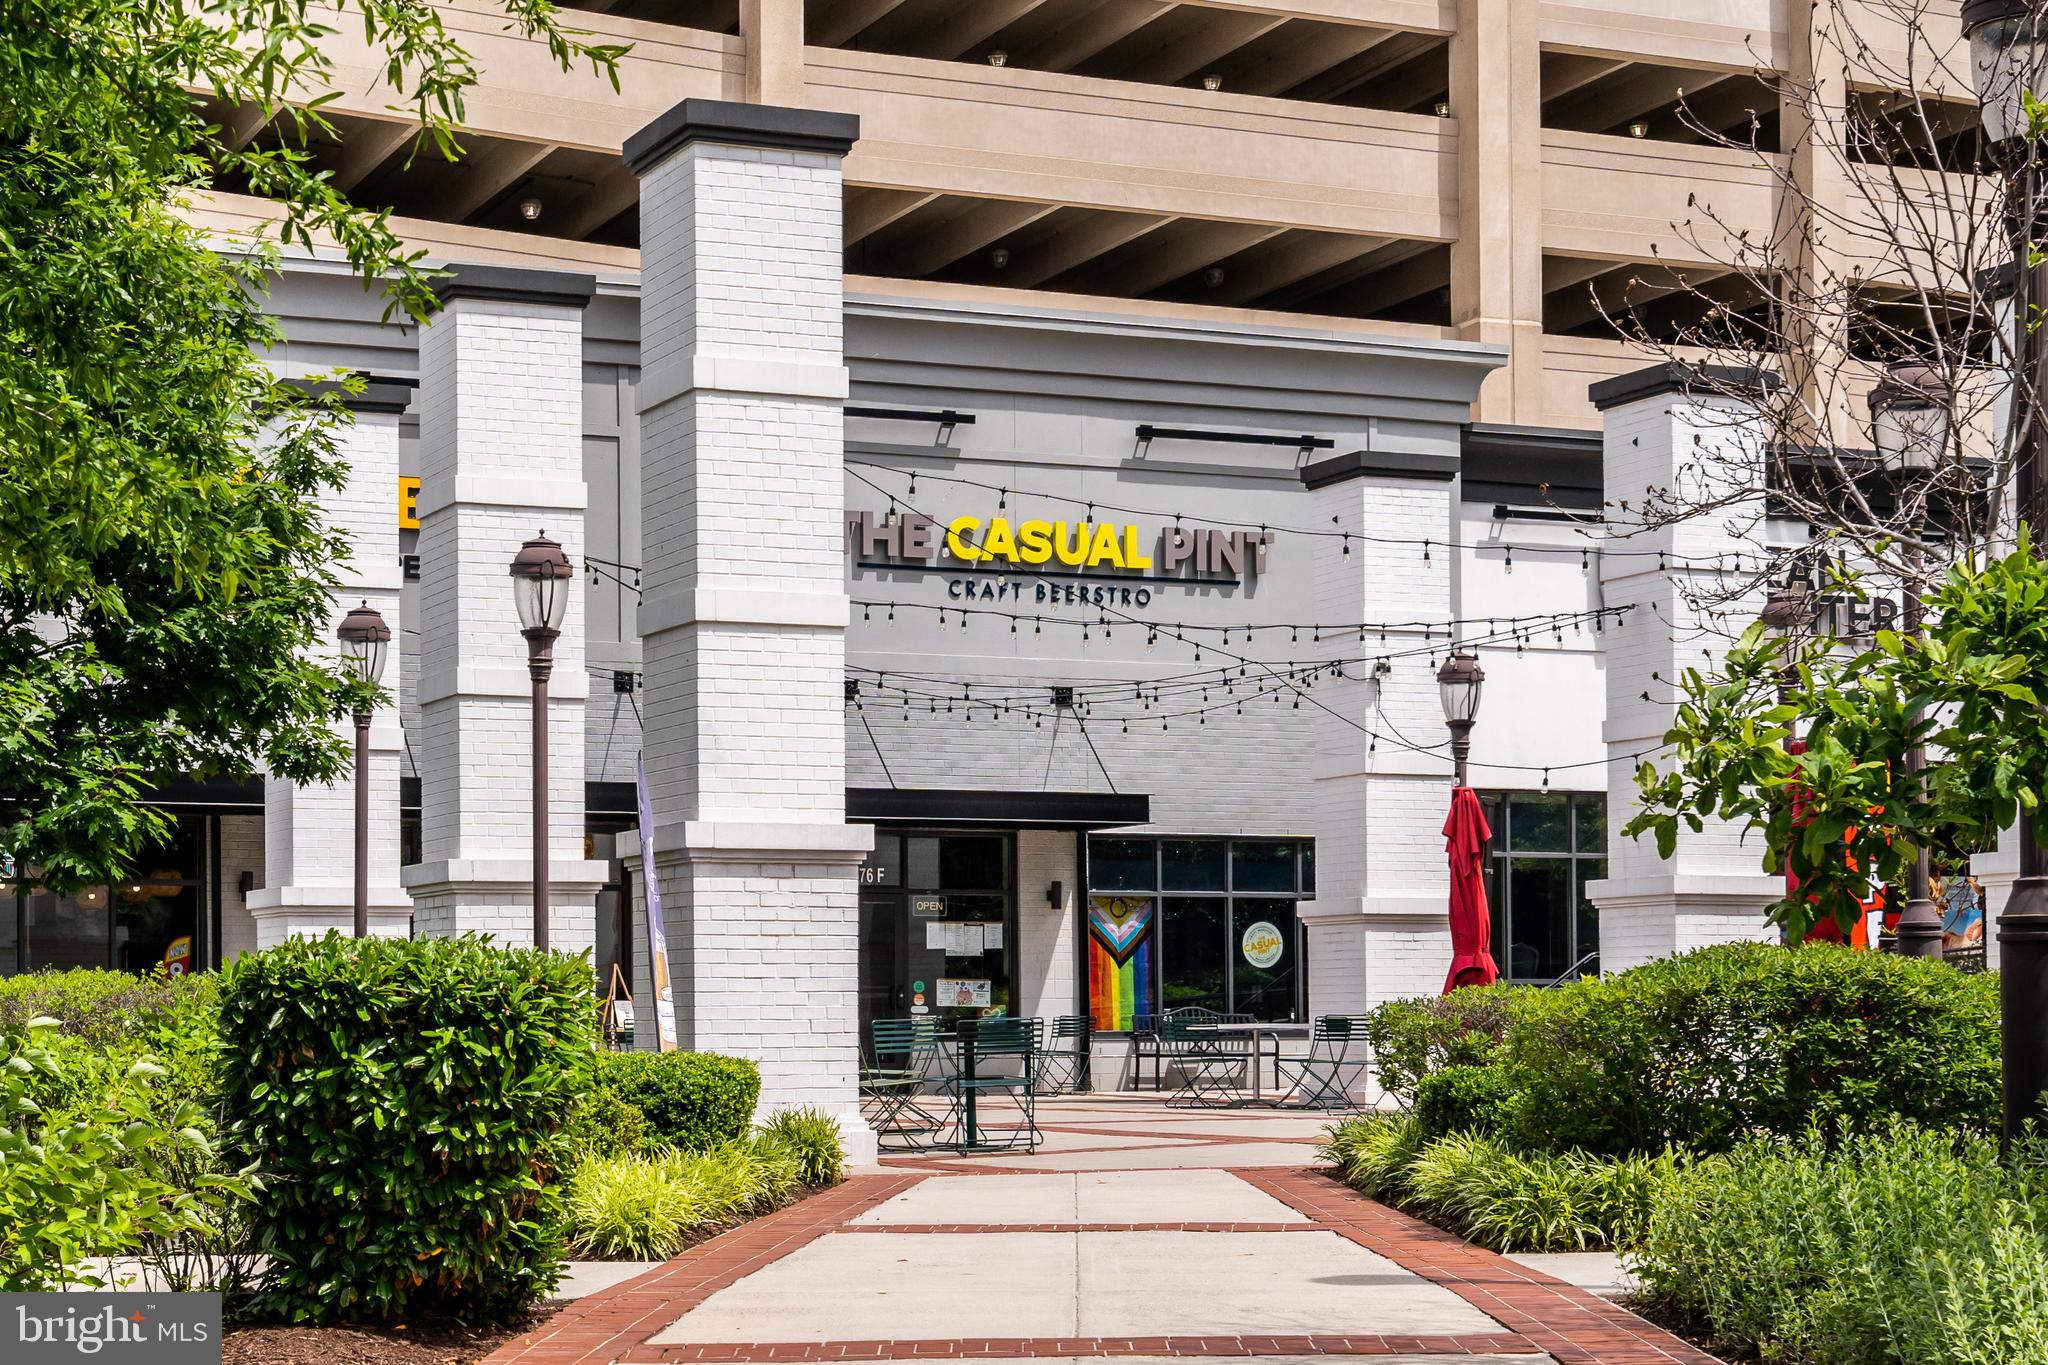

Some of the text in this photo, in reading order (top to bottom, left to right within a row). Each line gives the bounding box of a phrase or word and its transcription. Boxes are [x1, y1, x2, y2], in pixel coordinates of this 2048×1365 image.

[946, 515, 1153, 570] CASUAL
[1161, 526, 1275, 575] PINT
[948, 579, 1152, 607] CRAFT BEERSTRO
[877, 867, 885, 883] F
[916, 901, 944, 911] OPEN
